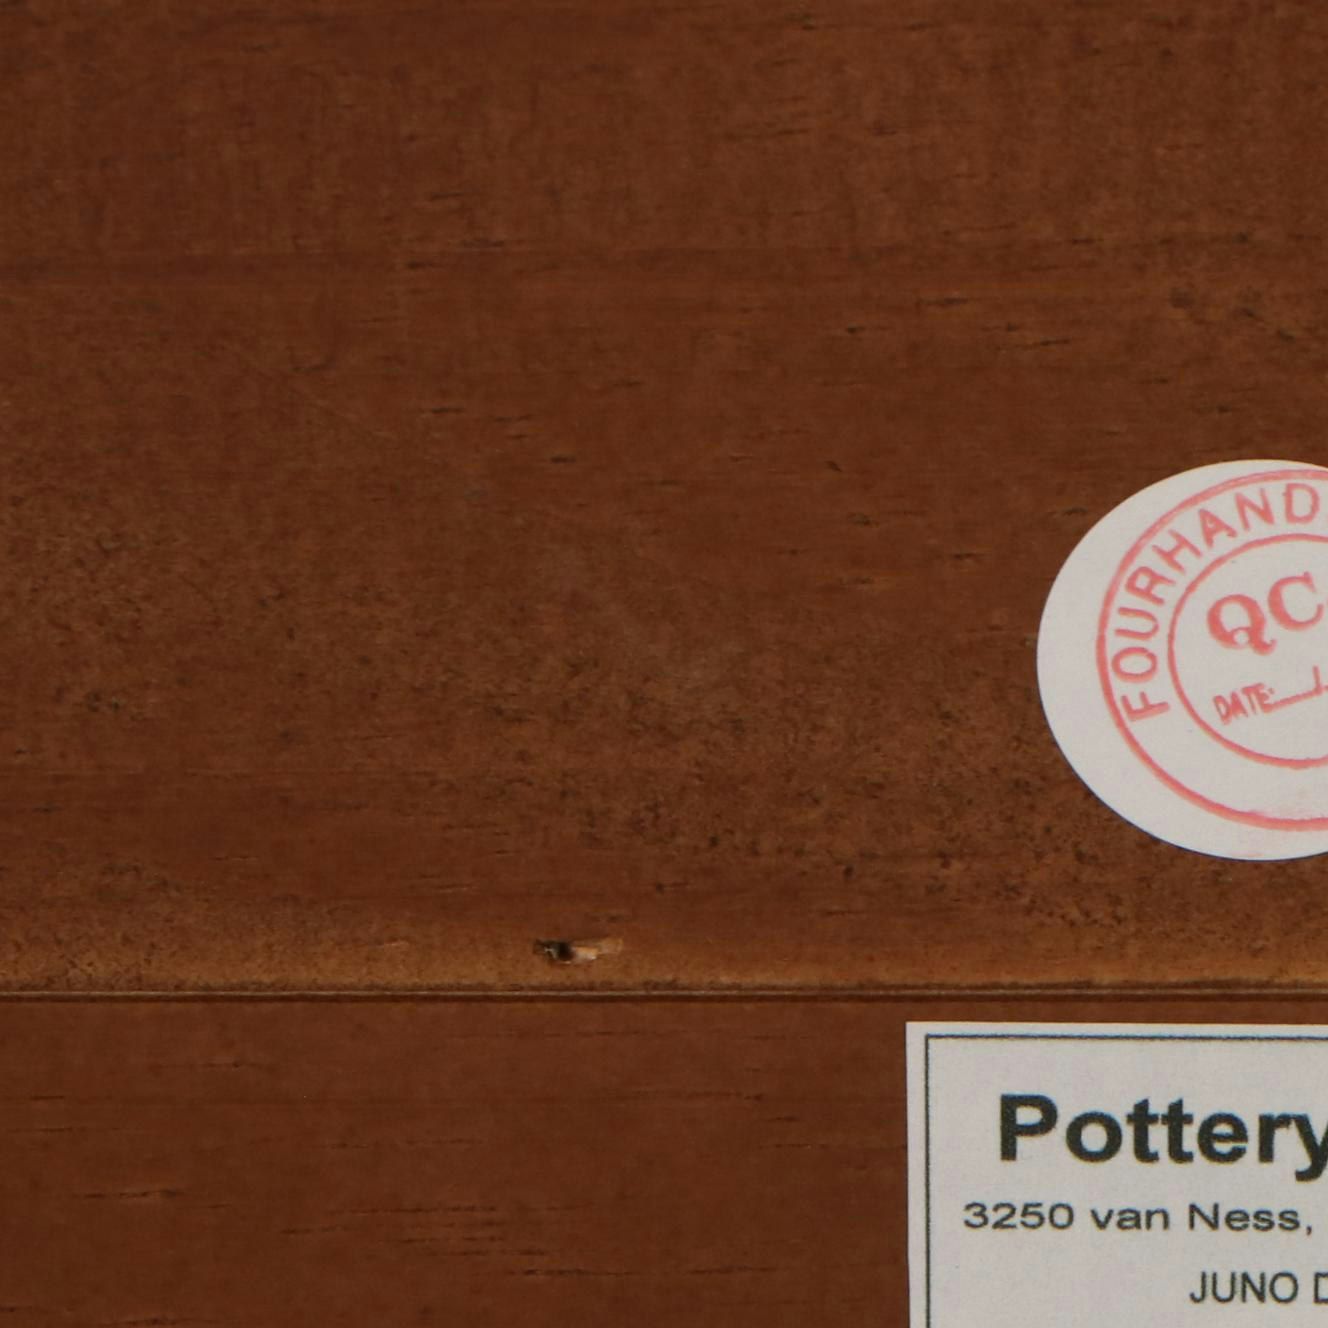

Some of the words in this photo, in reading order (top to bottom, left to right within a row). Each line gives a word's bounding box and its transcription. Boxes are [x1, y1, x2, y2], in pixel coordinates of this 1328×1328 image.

[963, 1201, 1075, 1231] 3250
[1089, 1207, 1171, 1232] van
[1188, 1202, 1313, 1236] Ness,
[1188, 1270, 1300, 1305] JUNO
